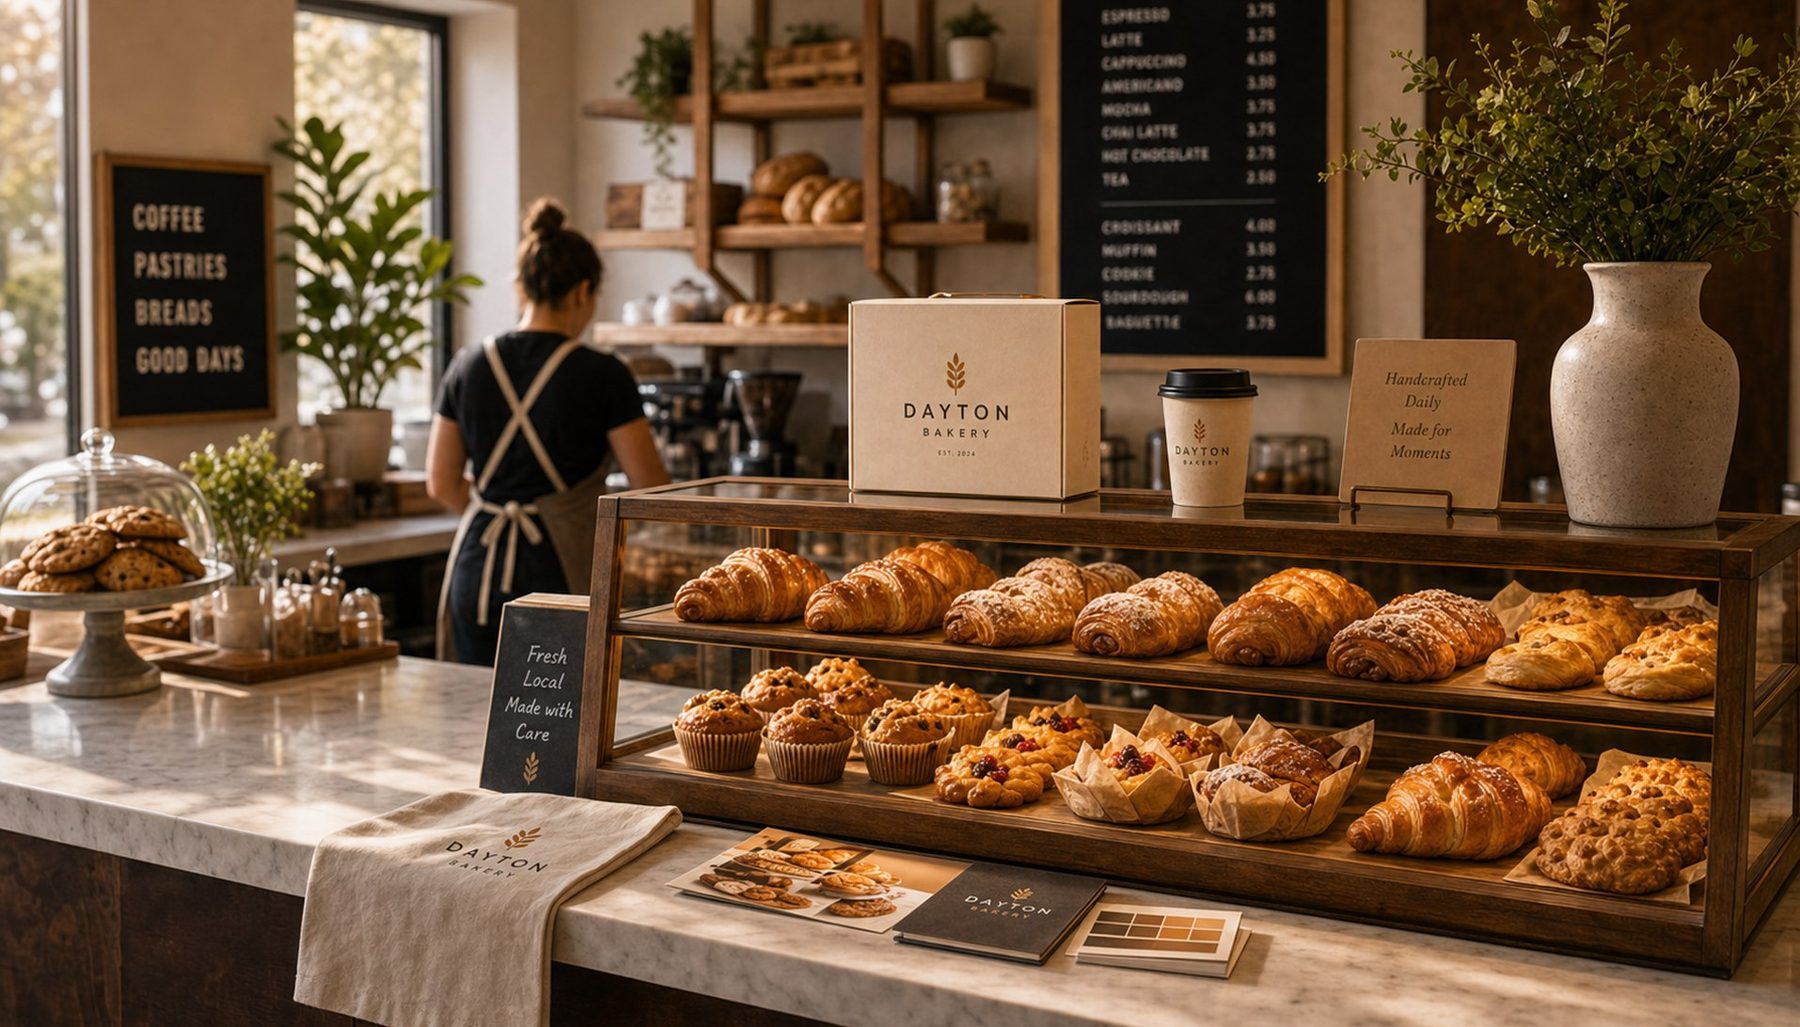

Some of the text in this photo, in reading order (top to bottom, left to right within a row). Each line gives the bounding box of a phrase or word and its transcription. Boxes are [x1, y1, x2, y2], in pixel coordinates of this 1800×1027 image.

[1102, 8, 1170, 24] ESPRESSO
[1102, 33, 1141, 47] LATTE
[1102, 54, 1186, 70] CAPPUCCINO
[1102, 78, 1183, 93] AMERICANO
[1102, 103, 1151, 117] MOCHA
[1102, 126, 1134, 140] CHAI
[1137, 124, 1177, 139] LATTE
[1102, 149, 1128, 163] HOT
[1132, 147, 1208, 162] CHOCOLATE
[1103, 173, 1129, 186] TEA
[133, 204, 203, 232] COFFEE
[1102, 220, 1180, 235] CROISSANT
[1102, 244, 1156, 257] MUFFIN
[135, 252, 226, 279] PASTRIES
[1102, 267, 1153, 281] COOKIE
[1103, 290, 1188, 304] SOURDOUGH
[135, 299, 212, 325] BREADS
[1106, 315, 1179, 329] BAGUETTE
[136, 346, 243, 374] GOOD DAYS
[1385, 371, 1468, 390] Handcrafted
[1405, 394, 1441, 412] Daily
[904, 403, 1009, 421] DAYTON
[923, 428, 990, 439] BAKERY
[1391, 422, 1452, 440] Made for
[1175, 446, 1230, 456] DAYTON
[1390, 445, 1451, 460] Moments
[527, 645, 567, 665] Fresh
[523, 670, 565, 690] Local
[505, 697, 573, 718] Made with
[515, 723, 550, 742] Care
[446, 841, 548, 872] DAYTON
[449, 859, 515, 878] BAKERY
[965, 895, 1051, 915] DAYTON
